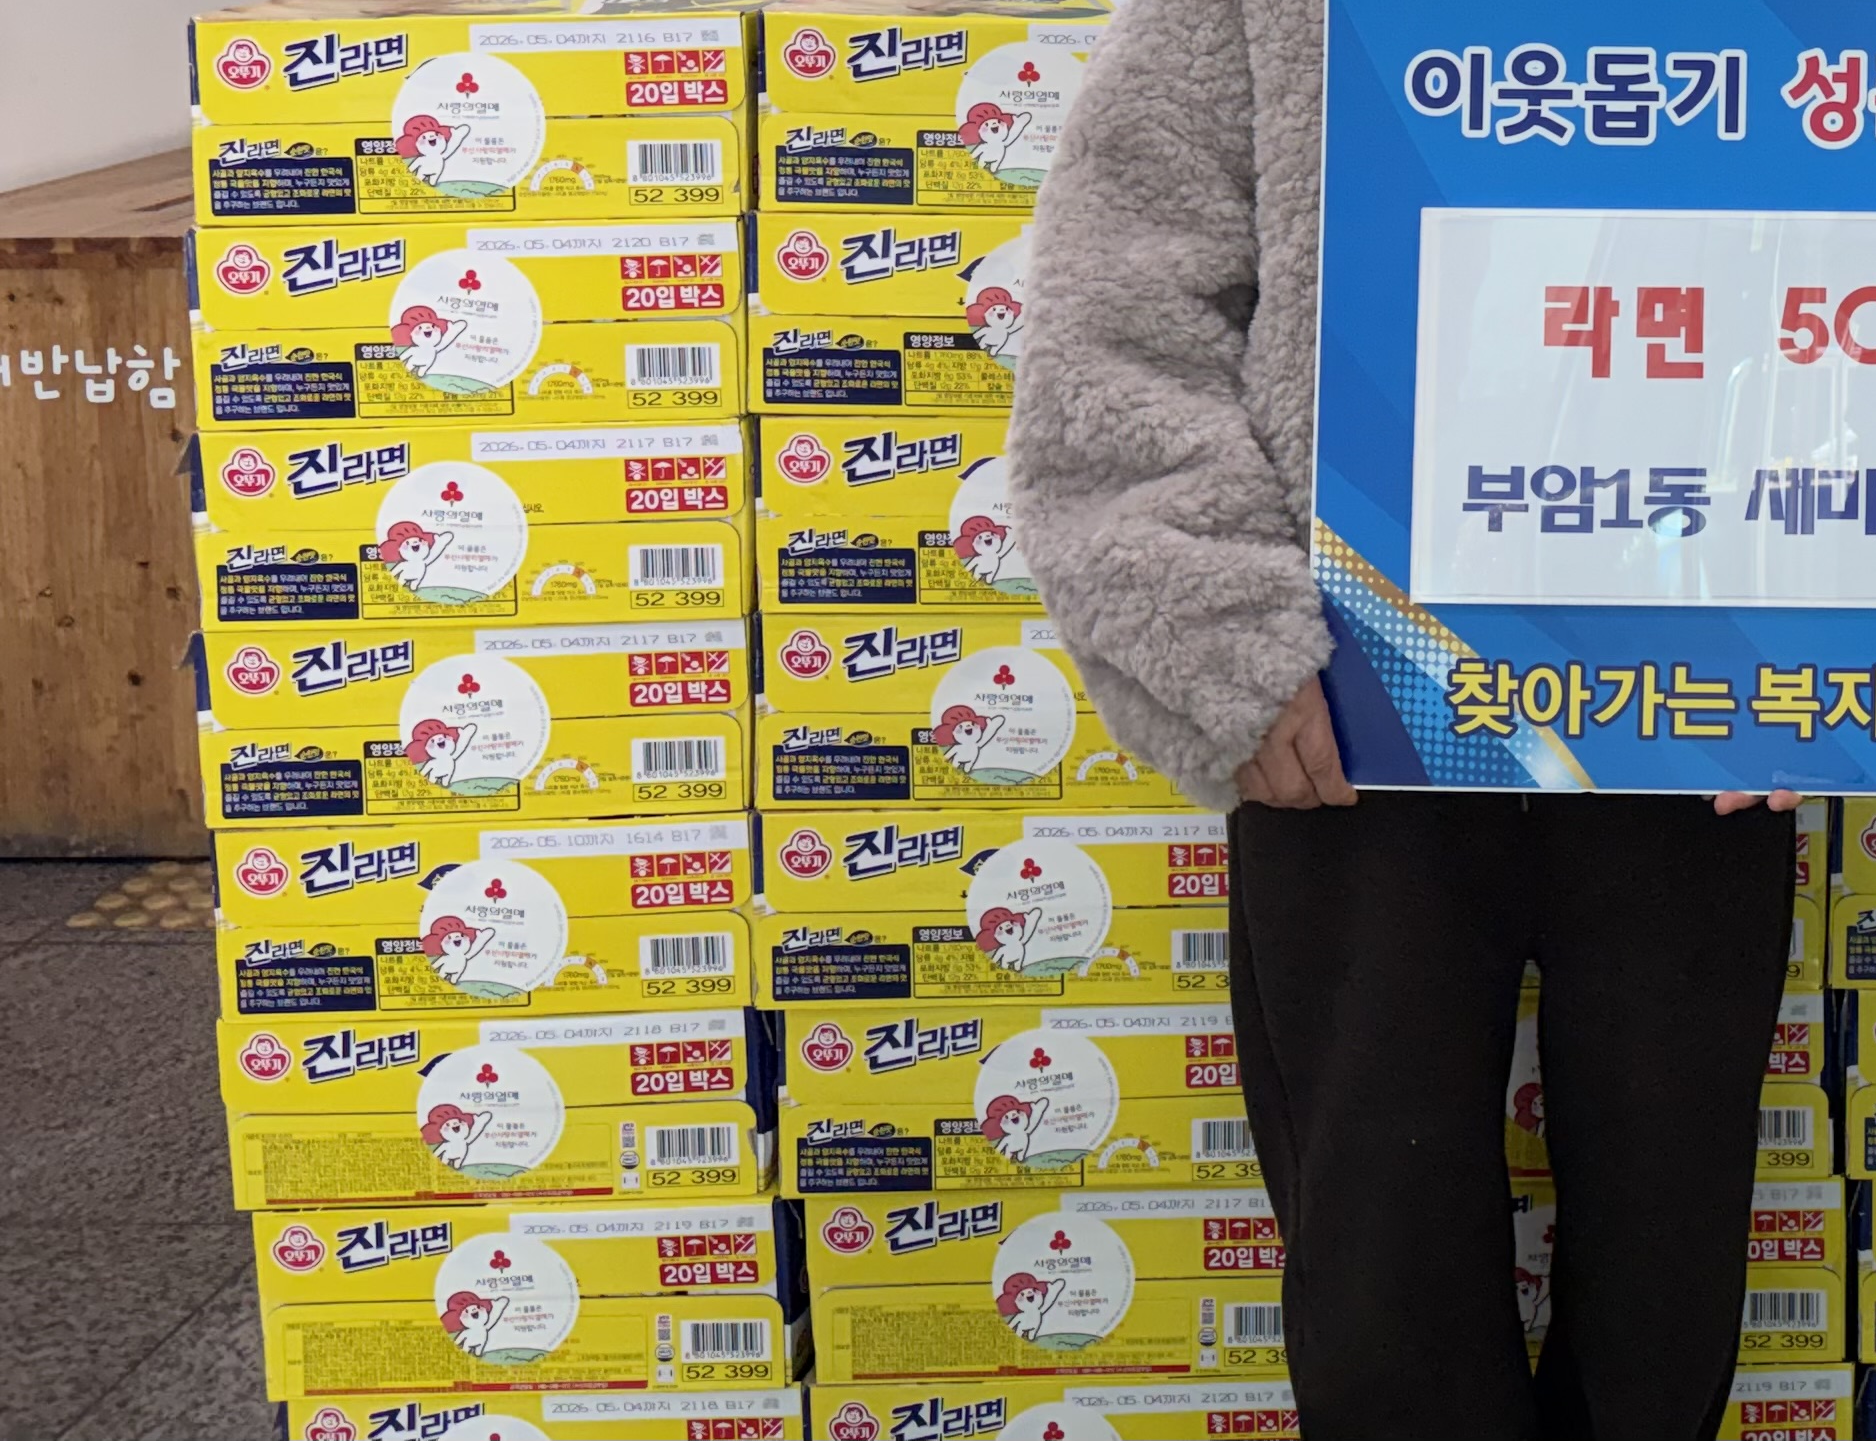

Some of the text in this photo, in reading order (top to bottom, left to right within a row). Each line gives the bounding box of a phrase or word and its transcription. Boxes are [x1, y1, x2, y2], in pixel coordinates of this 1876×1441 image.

[616, 33, 655, 44] 2116
[663, 32, 692, 43] B17
[283, 33, 408, 91] 진라면
[793, 55, 826, 68] 오뚜기
[847, 29, 967, 82] 진라면
[228, 64, 261, 79] 오뚜기
[630, 82, 725, 104] 20입 박스
[1406, 45, 1747, 146] 이웃돕기
[633, 187, 719, 203] 52 399
[787, 257, 820, 271] 오뚜기
[840, 229, 961, 284] 진라면
[773, 328, 833, 355] 진라면
[909, 334, 955, 348] 영양정보
[1542, 284, 1705, 380] 라면
[907, 351, 931, 360] 나트륨
[911, 372, 941, 380] 포화지방
[914, 382, 937, 390] 단백질
[1461, 463, 1710, 537] 부암1동
[1447, 659, 1738, 740] 찾아가는
[625, 831, 664, 846] 1614
[670, 829, 701, 843] B17
[247, 871, 279, 887] 오뚜기
[299, 841, 419, 898] 진라면
[636, 882, 731, 905] 20입 박스
[336, 1221, 453, 1273] 진라면
[1742, 1331, 1824, 1350] 52 399
[685, 1363, 770, 1380] 52 399
